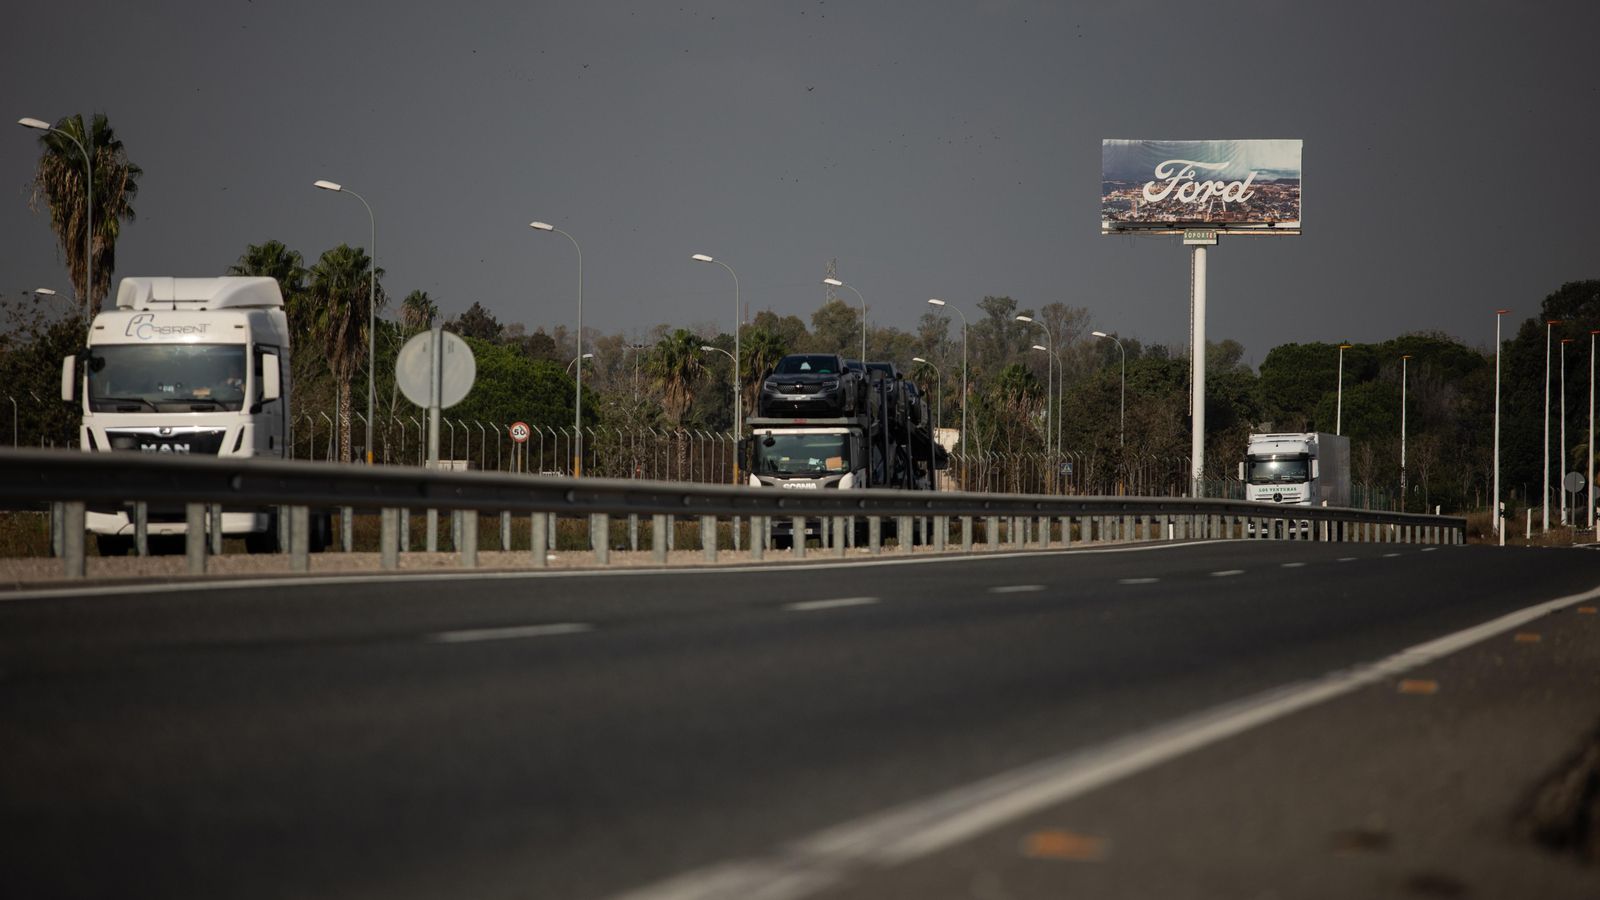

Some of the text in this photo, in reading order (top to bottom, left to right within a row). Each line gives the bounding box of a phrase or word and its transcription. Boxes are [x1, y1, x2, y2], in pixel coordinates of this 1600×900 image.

[1142, 159, 1258, 204] Ford
[514, 428, 526, 436] 50
[140, 443, 191, 454] MAN
